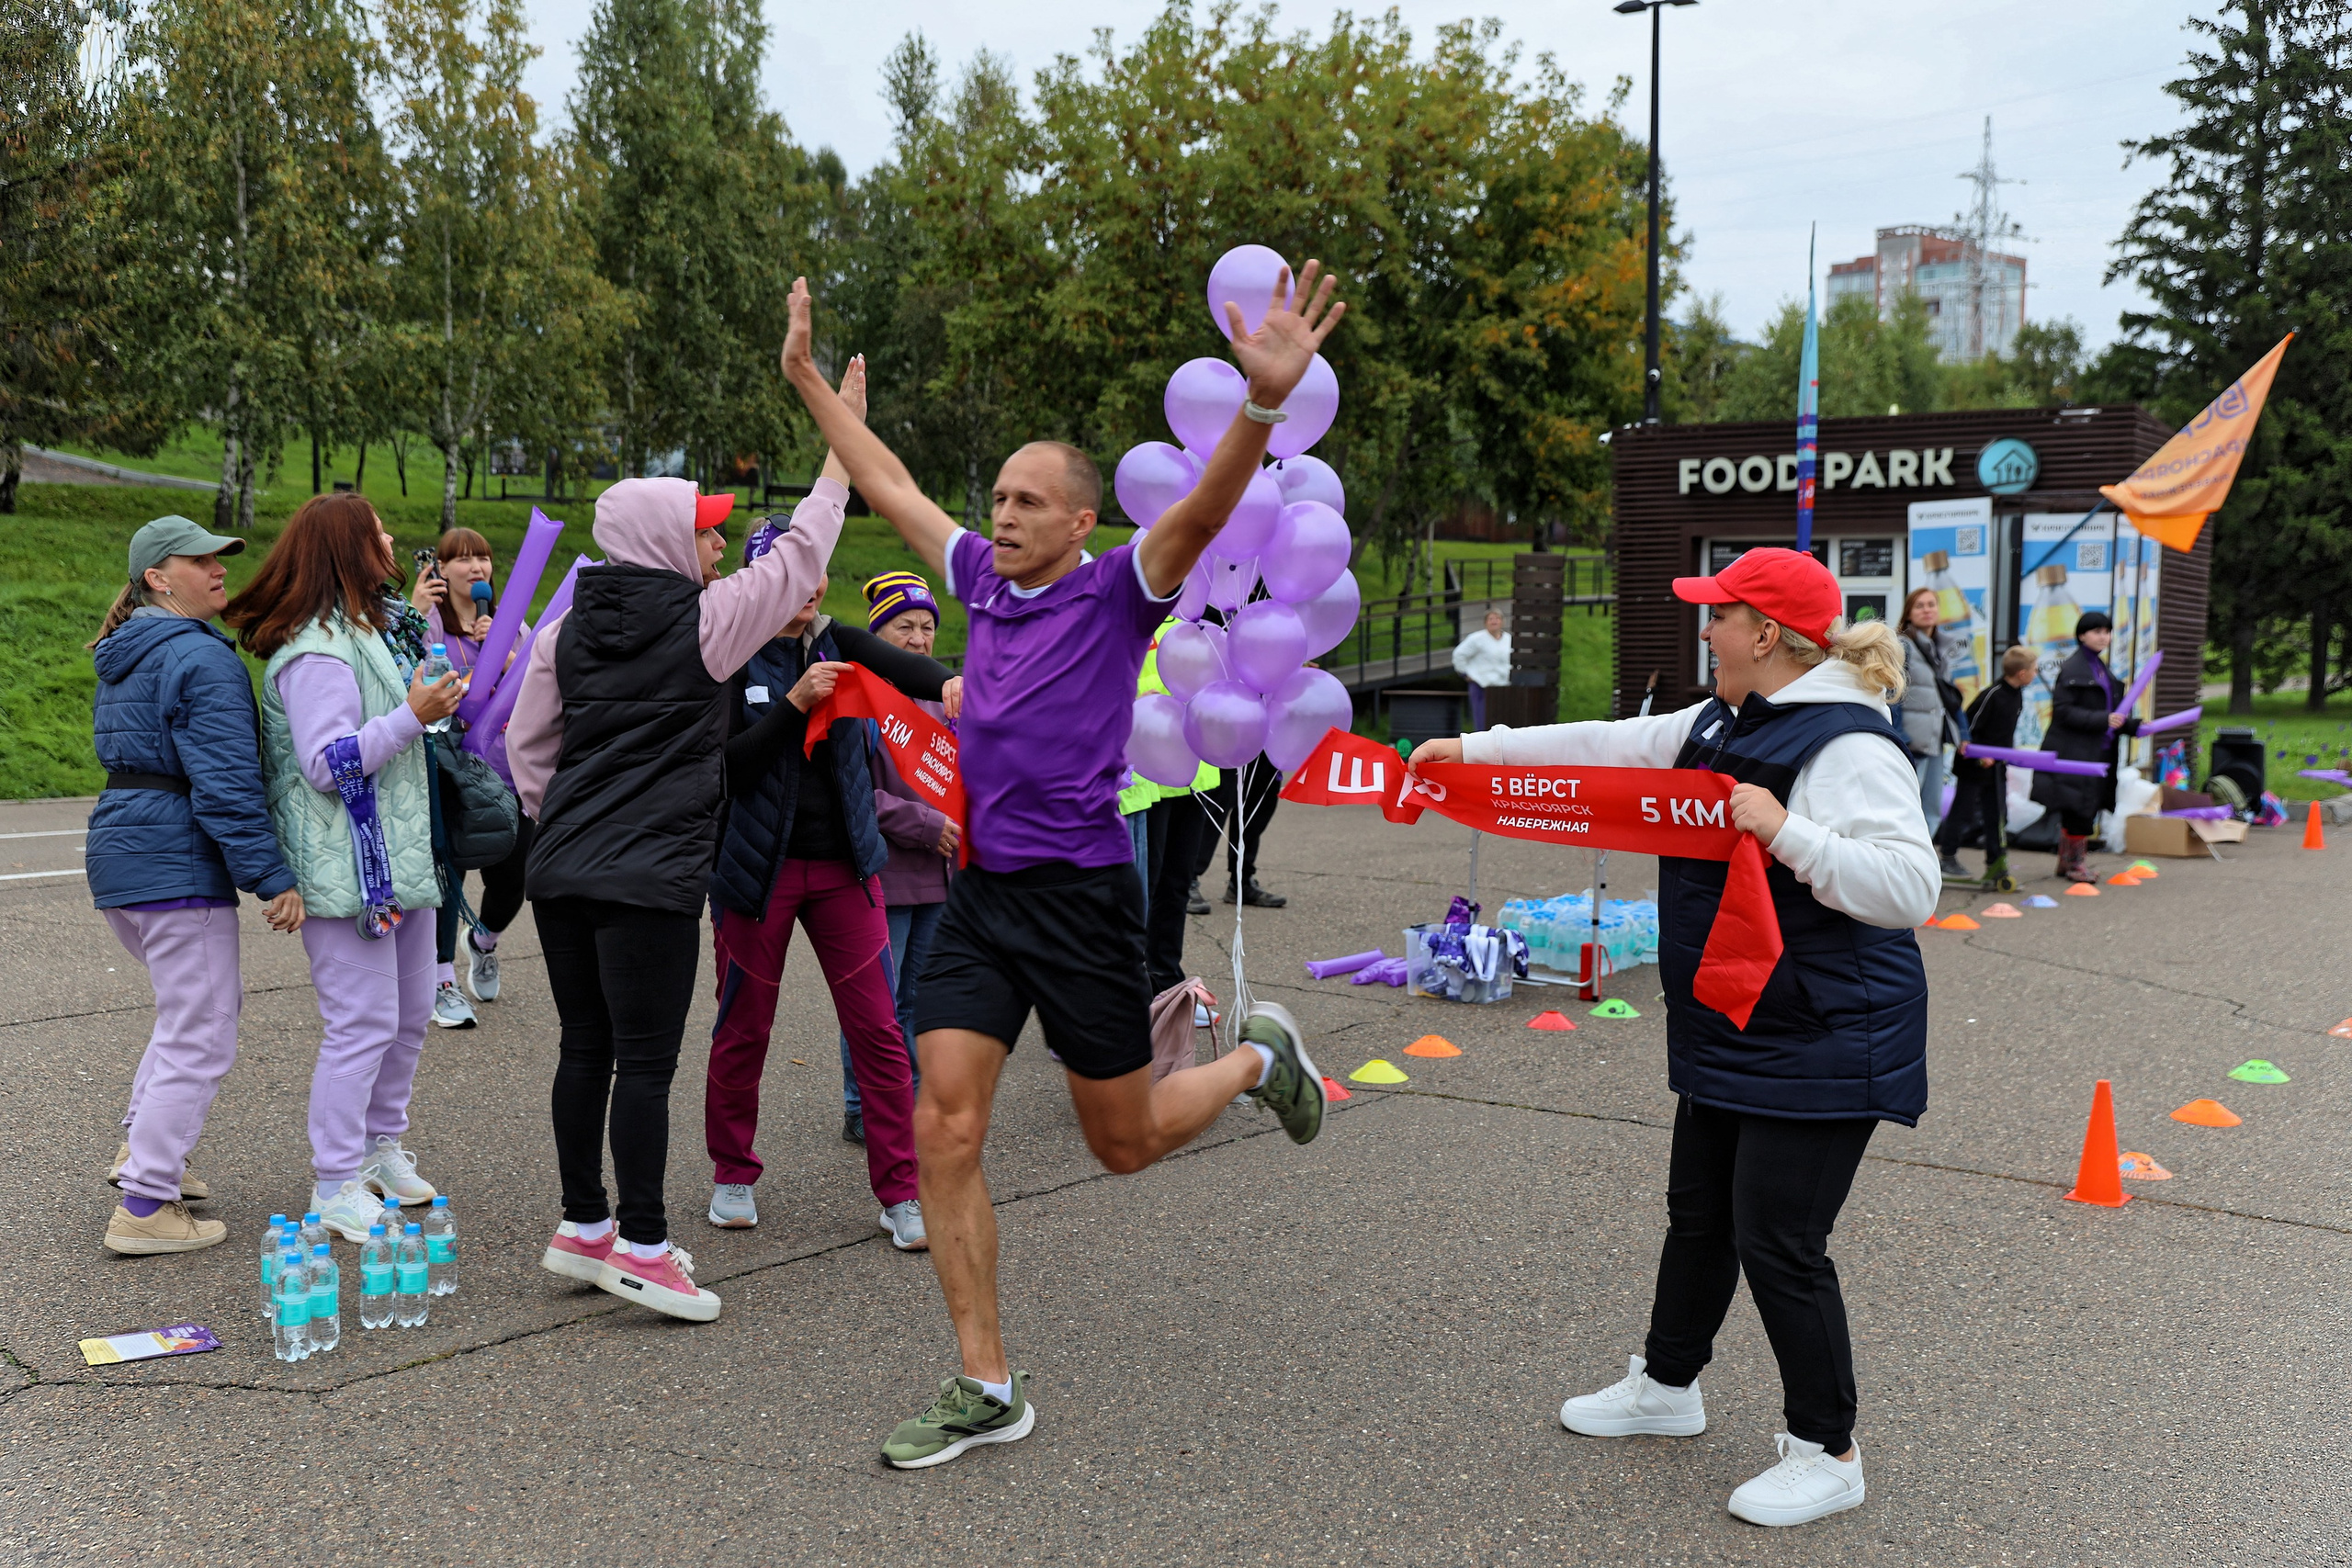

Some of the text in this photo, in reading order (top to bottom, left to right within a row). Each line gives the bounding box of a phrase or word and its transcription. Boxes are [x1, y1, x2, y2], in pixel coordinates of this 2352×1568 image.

[1679, 454, 1798, 495] FOOD
[1824, 447, 1955, 490] PARK
[881, 714, 913, 749] 5 КМ
[930, 732, 956, 764] 5 ВЁРСТ
[914, 767, 947, 797] НАБЕРЕЖНАЯ
[921, 750, 955, 784] КРАСНОЯРСК
[332, 767, 353, 804] ЖИЗНЬ
[1491, 773, 1581, 798] 5 ВЁРСТ
[1490, 798, 1594, 817] КРАСНОЯРСК
[1641, 796, 1726, 829] 5 КМ
[1497, 815, 1589, 834] НАБЕРЕЖНАЯ
